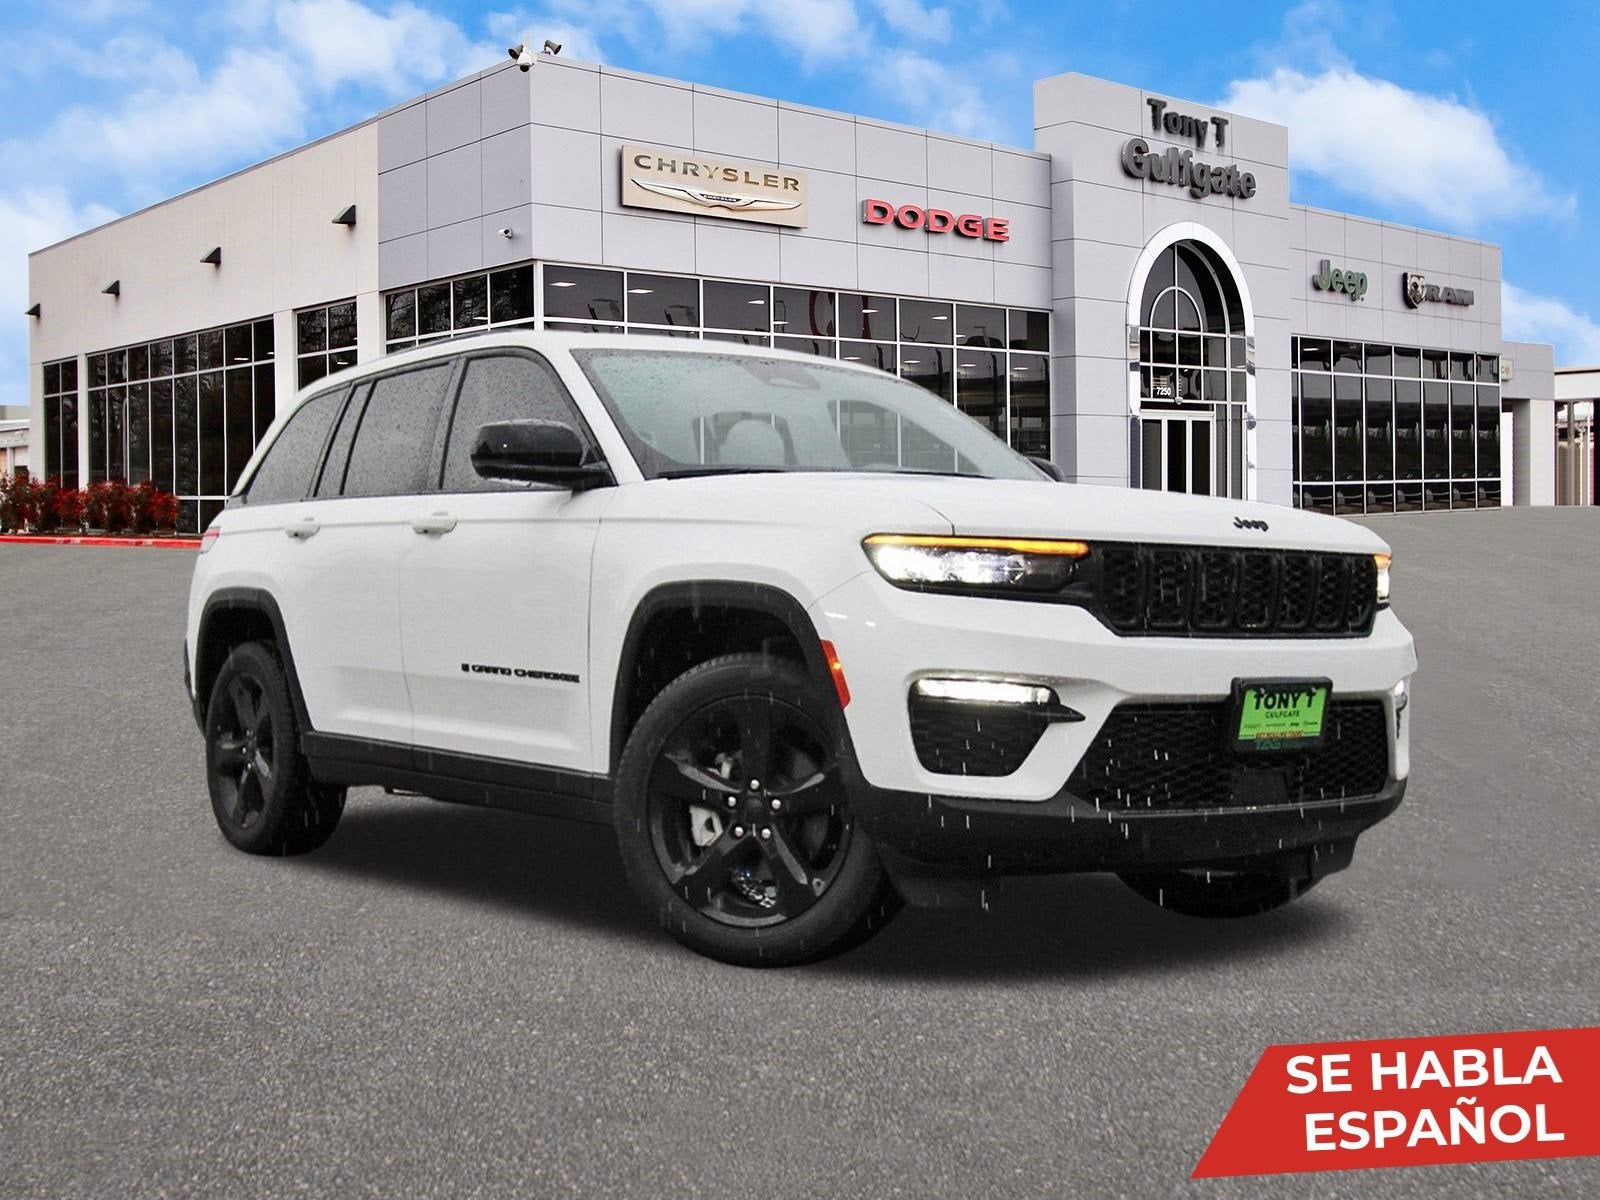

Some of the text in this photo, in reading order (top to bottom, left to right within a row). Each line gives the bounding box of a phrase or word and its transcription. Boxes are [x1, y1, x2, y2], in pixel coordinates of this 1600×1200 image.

[1147, 98, 1229, 148] Tony T
[634, 154, 800, 191] CHRYSLER
[1121, 138, 1256, 199] Gulfgate
[862, 199, 1010, 242] DODGE
[1312, 259, 1368, 302] Jeep
[1425, 284, 1475, 306] RAM
[1156, 386, 1172, 396] 7250
[1233, 516, 1269, 532] Jeep
[471, 664, 580, 683] GRAND CHEROKEE
[1253, 689, 1317, 710] TONY T
